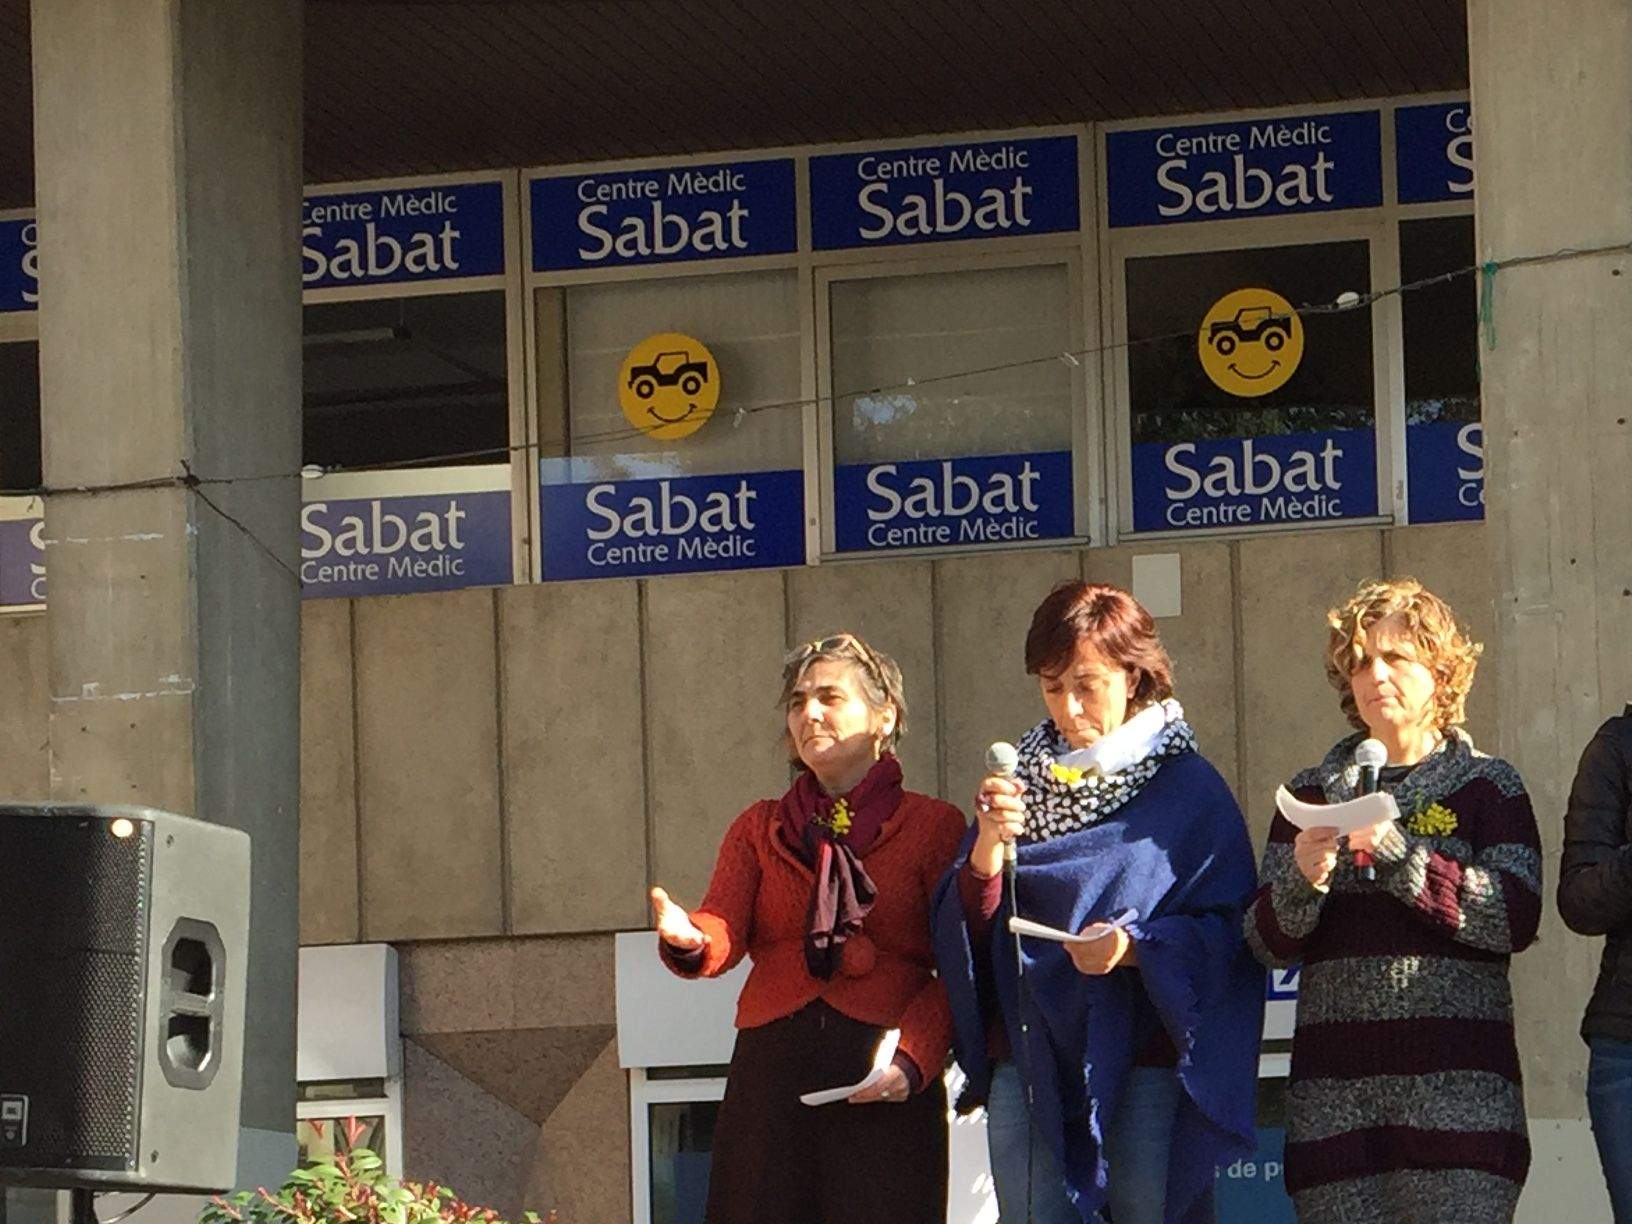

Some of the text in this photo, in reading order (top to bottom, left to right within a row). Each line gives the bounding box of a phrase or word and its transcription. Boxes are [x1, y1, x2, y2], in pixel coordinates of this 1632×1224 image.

[1155, 122, 1332, 157] Centre Mèdic
[858, 147, 1029, 181] Centre Mèdic
[577, 170, 746, 203] Centre Mèdic
[1156, 152, 1335, 217] Sabat
[380, 192, 458, 218] Mèdic
[858, 176, 1033, 240] Sabat
[577, 199, 749, 261] Sabat
[302, 220, 461, 282] Sabat
[1164, 439, 1343, 500] Sabat
[866, 461, 1041, 521] Sabat
[585, 481, 757, 541] Sabat
[1166, 495, 1342, 526] Centre Mèdic
[301, 500, 466, 558] Sabat
[867, 516, 1039, 547] Centre Mèdic
[587, 535, 755, 566] Centre Mèdic
[301, 555, 465, 583] Centre Mèdic
[1227, 1158, 1257, 1179] de
